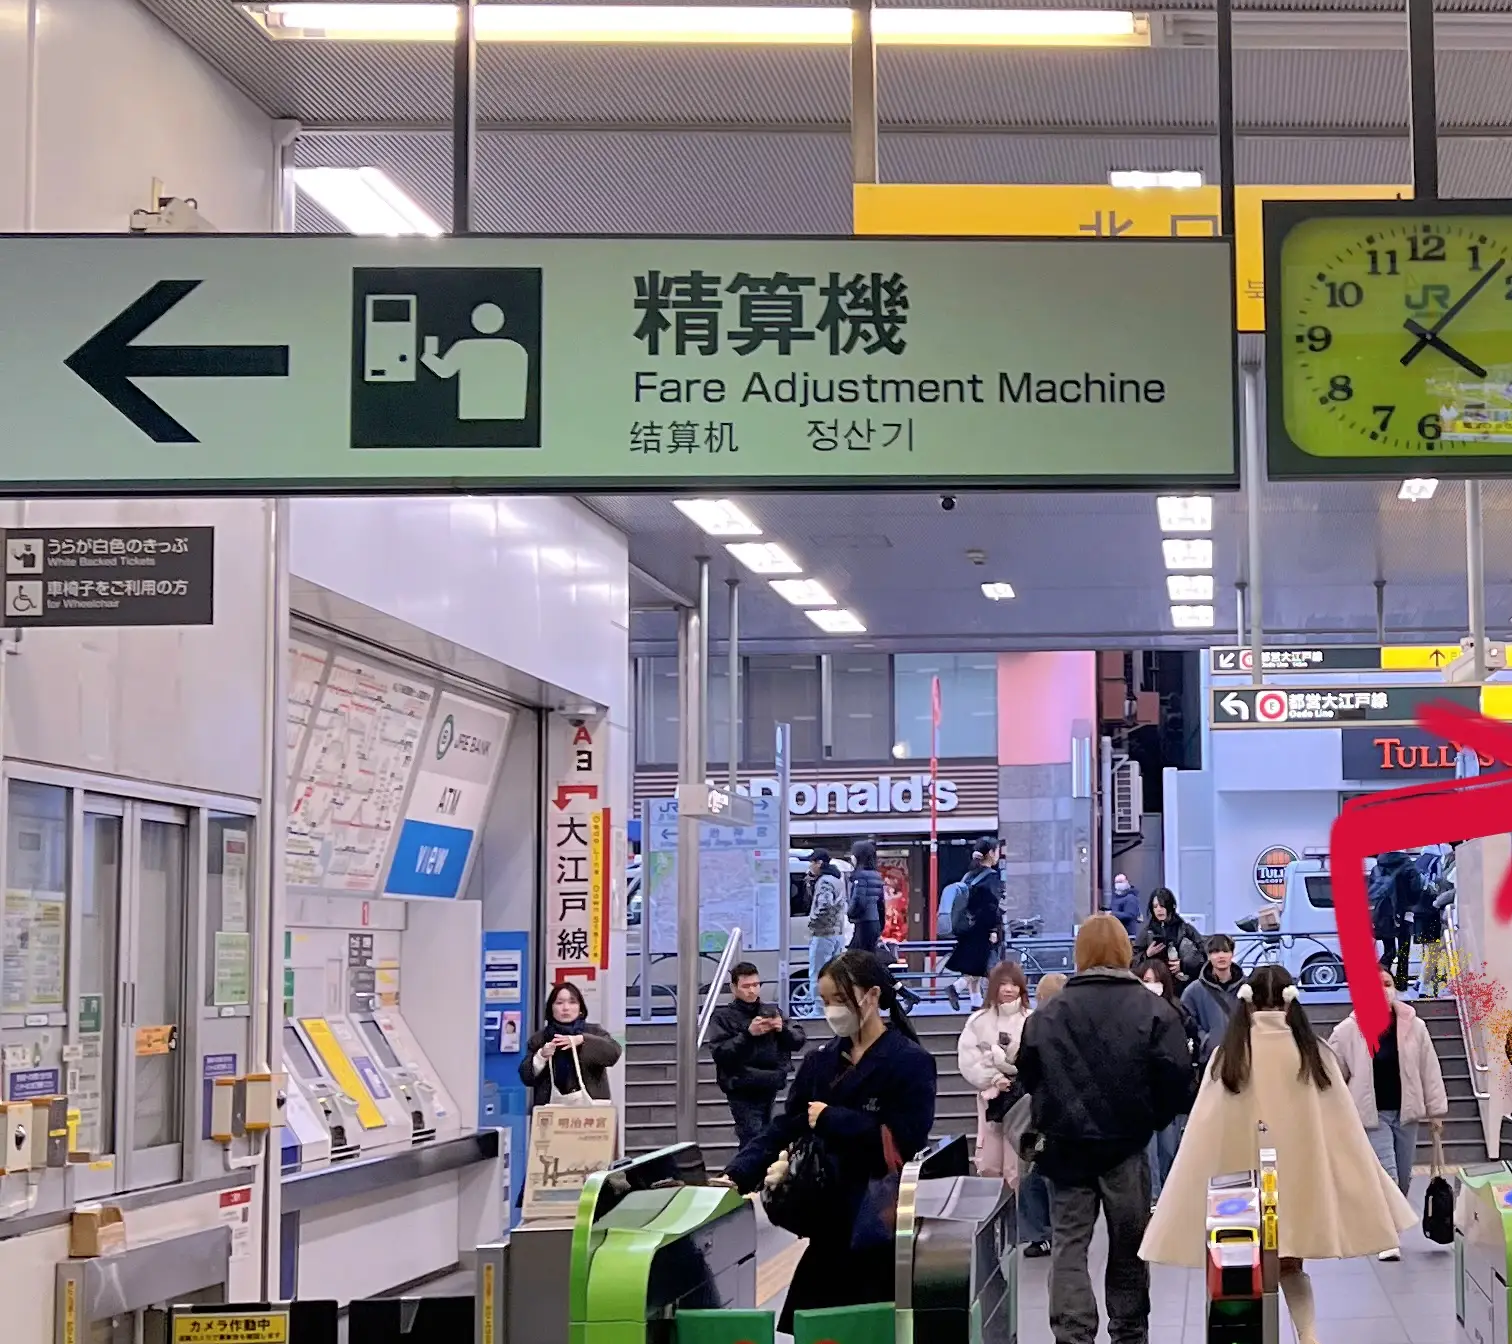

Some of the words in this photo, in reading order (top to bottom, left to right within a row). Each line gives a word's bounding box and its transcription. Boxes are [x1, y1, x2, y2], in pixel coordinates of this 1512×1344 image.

[1407, 235, 1446, 261] 12
[1468, 245, 1482, 271] 1
[1367, 250, 1400, 275] 11
[1325, 281, 1364, 308] 10
[1405, 284, 1451, 310] JR
[632, 269, 911, 357] 精算機
[1306, 325, 1333, 352] 9
[634, 371, 727, 404] Fare
[742, 370, 985, 408] Adjustment
[999, 371, 1167, 404] Machine
[1327, 375, 1354, 401] 8
[1372, 405, 1395, 432] 7
[1417, 414, 1442, 440] 6
[629, 419, 740, 455] 结算机
[806, 417, 915, 453] 정산기
[47, 537, 189, 555] うらが白色のきっぷ
[47, 557, 77, 567] White
[47, 579, 189, 597] 車椅子をご利用の方
[1289, 692, 1388, 710] 都営大江戸線
[556, 816, 589, 961] 大江戸線
[189, 1318, 271, 1333] カメラ作動中
